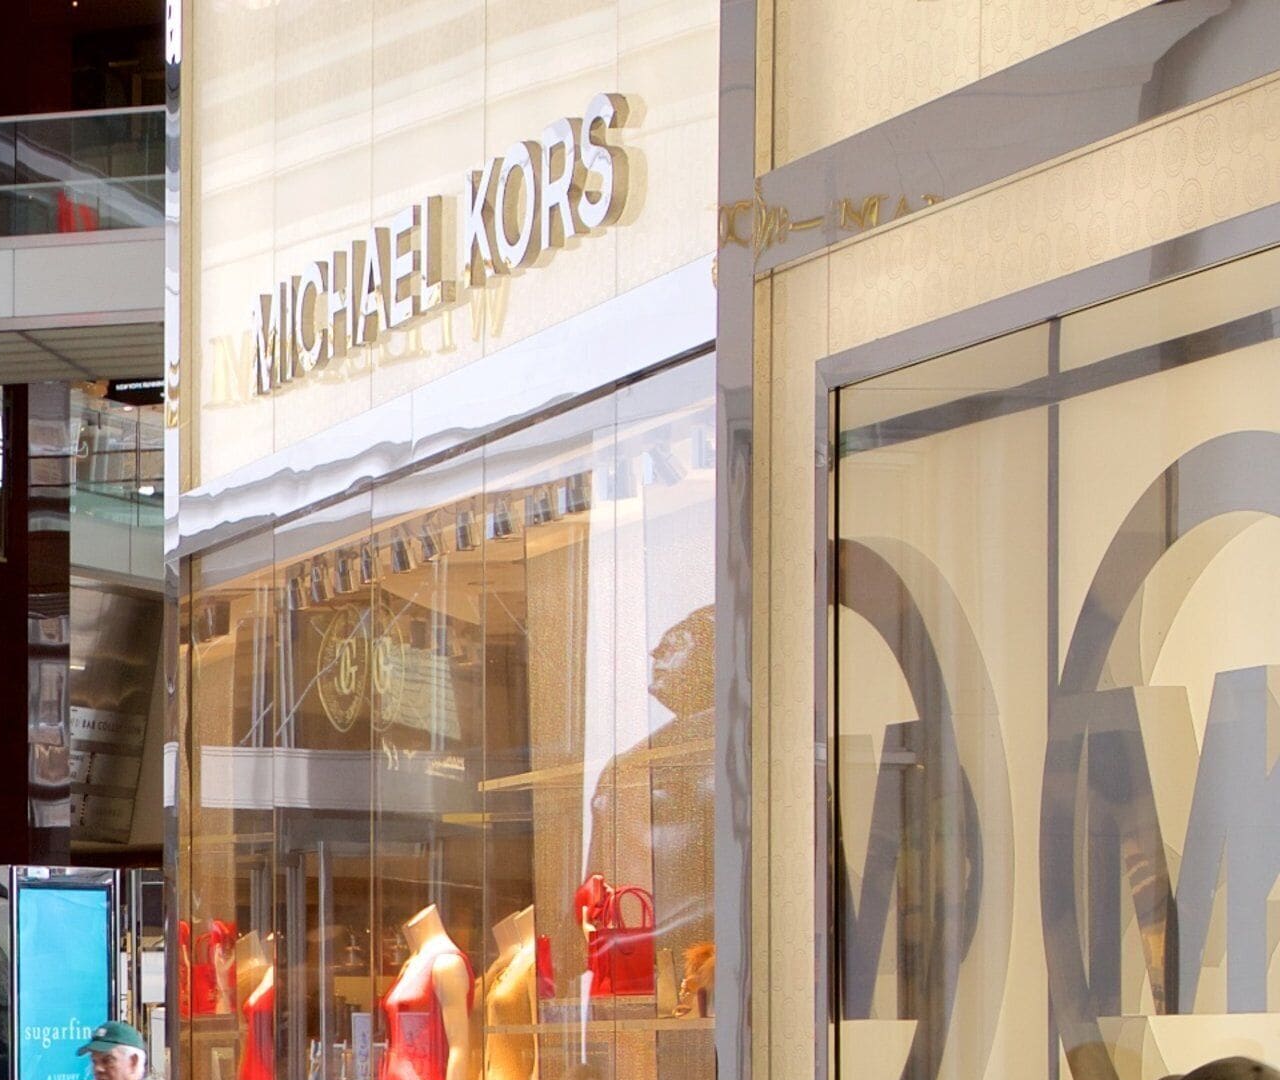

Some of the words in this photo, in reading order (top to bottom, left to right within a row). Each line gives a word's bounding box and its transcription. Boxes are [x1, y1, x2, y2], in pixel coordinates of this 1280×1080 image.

[251, 194, 443, 395] MICHAEL
[464, 93, 629, 289] KORS
[24, 1017, 92, 1049] sugarfin
